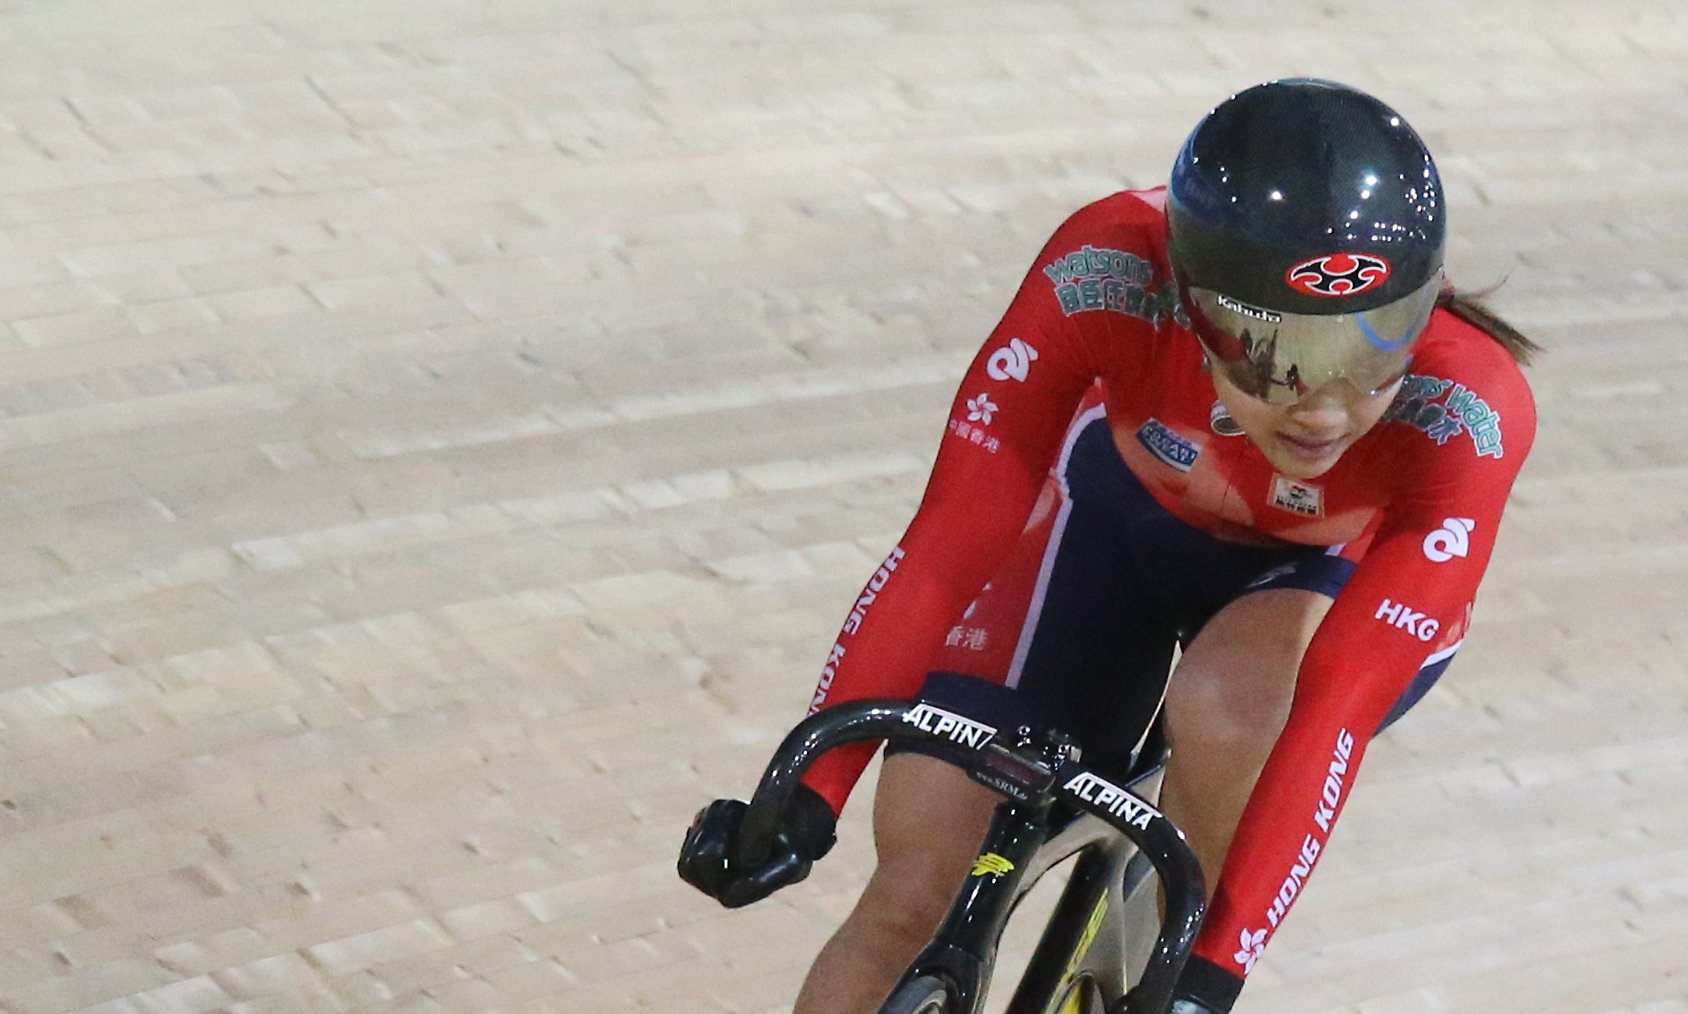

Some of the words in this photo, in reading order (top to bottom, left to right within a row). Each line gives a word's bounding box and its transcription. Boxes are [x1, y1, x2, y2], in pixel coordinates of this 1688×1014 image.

[1043, 245, 1153, 286] watsons
[1445, 384, 1504, 459] water
[844, 545, 906, 636] HONG
[1374, 598, 1440, 642] HKG
[807, 642, 847, 717] KON
[1063, 771, 1163, 831] ALPINA
[1266, 833, 1321, 928] HONG
[1314, 727, 1355, 833] KONG
